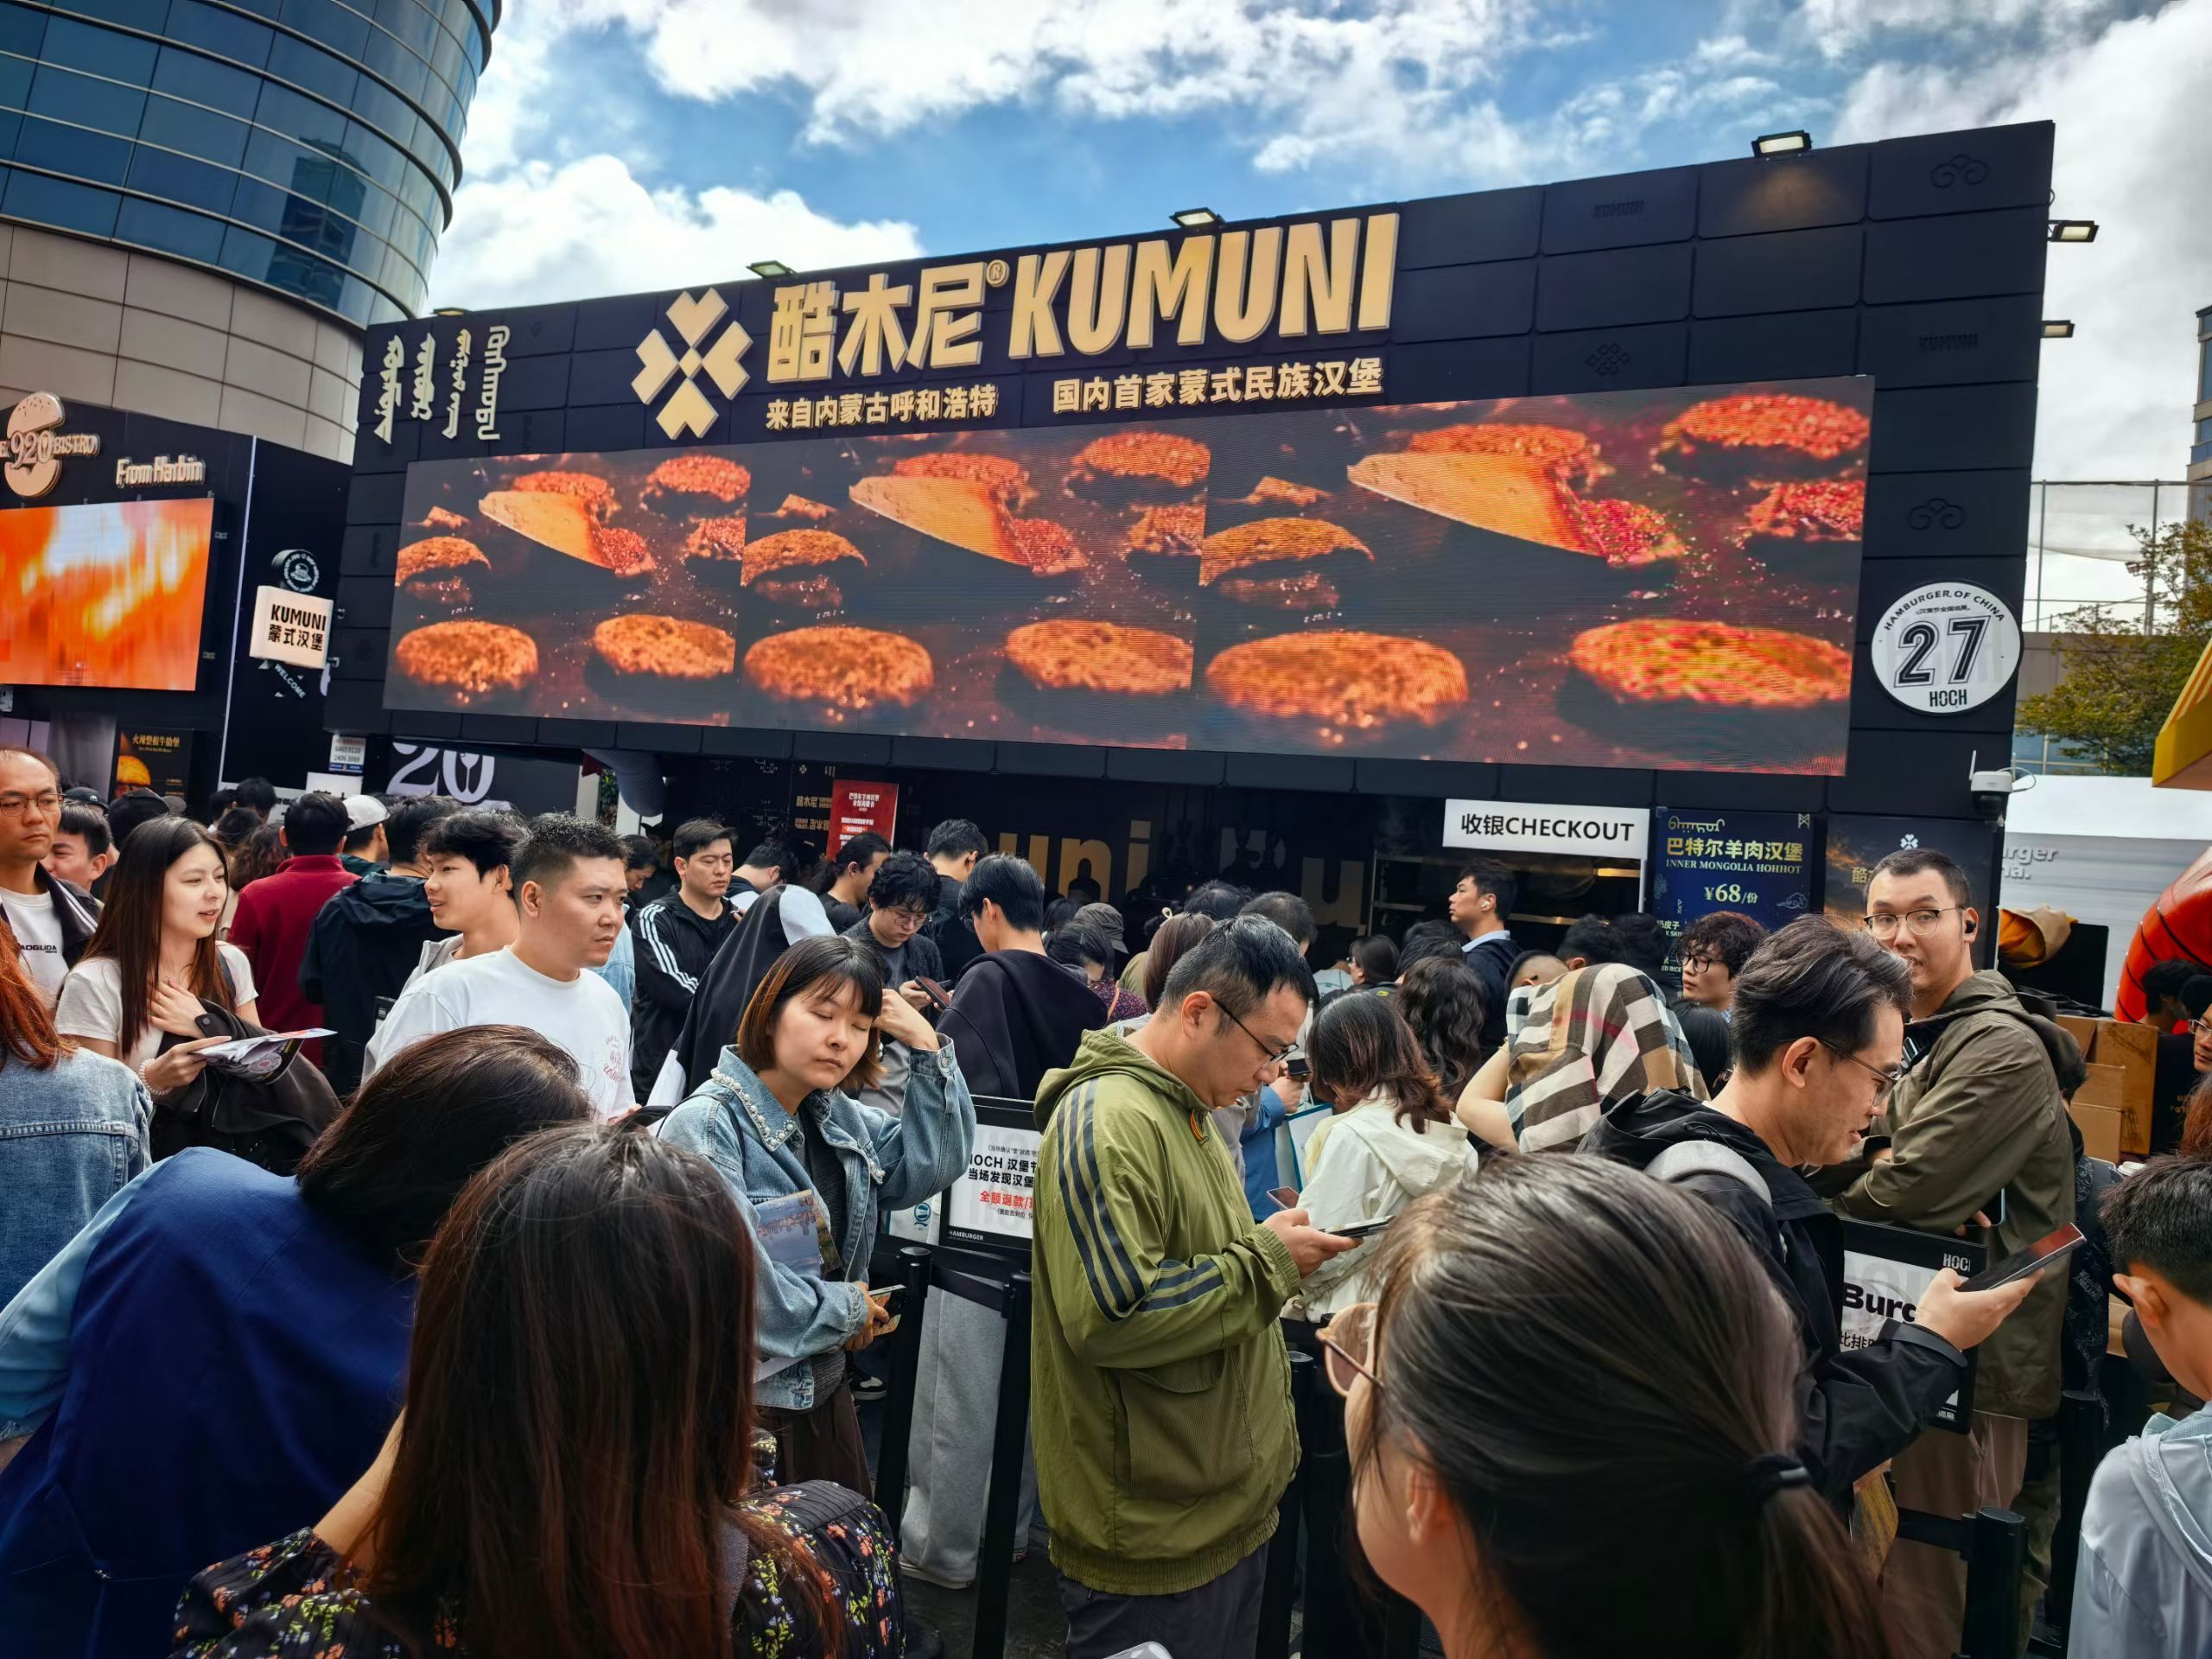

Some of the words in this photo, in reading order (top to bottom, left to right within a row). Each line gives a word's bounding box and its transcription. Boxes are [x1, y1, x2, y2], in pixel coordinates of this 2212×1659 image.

[1008, 212, 1400, 360] KUMUNI
[1052, 357, 1383, 413] 国内首家蒙式民族汉堡
[766, 384, 998, 430] 来自内蒙古呼和浩特
[10, 430, 54, 469] 920
[54, 434, 99, 455] BISTRO
[116, 457, 153, 487] From
[154, 454, 205, 482] Harbin
[270, 604, 327, 632] KUMUNI
[1884, 590, 1951, 631] HAMBURGER
[1954, 590, 1971, 599] OF
[1974, 595, 2005, 621] CHINA
[268, 623, 324, 652] 蒙式汉堡
[1894, 615, 1992, 688] 27
[274, 663, 307, 698] WELCOME
[1929, 689, 1967, 707] HOCH
[1460, 812, 1634, 843] 收银CHECKOUT
[1666, 836, 1803, 861] 巴特尔羊肉汉堡
[1666, 859, 1697, 869] INNER
[1700, 861, 1753, 873] MONGOLIA
[1757, 863, 1802, 874] HOHHOT
[1852, 867, 1872, 884] 酷
[969, 1168, 1034, 1188] 当场发现汉堡
[949, 1230, 984, 1241] HAMBURGER
